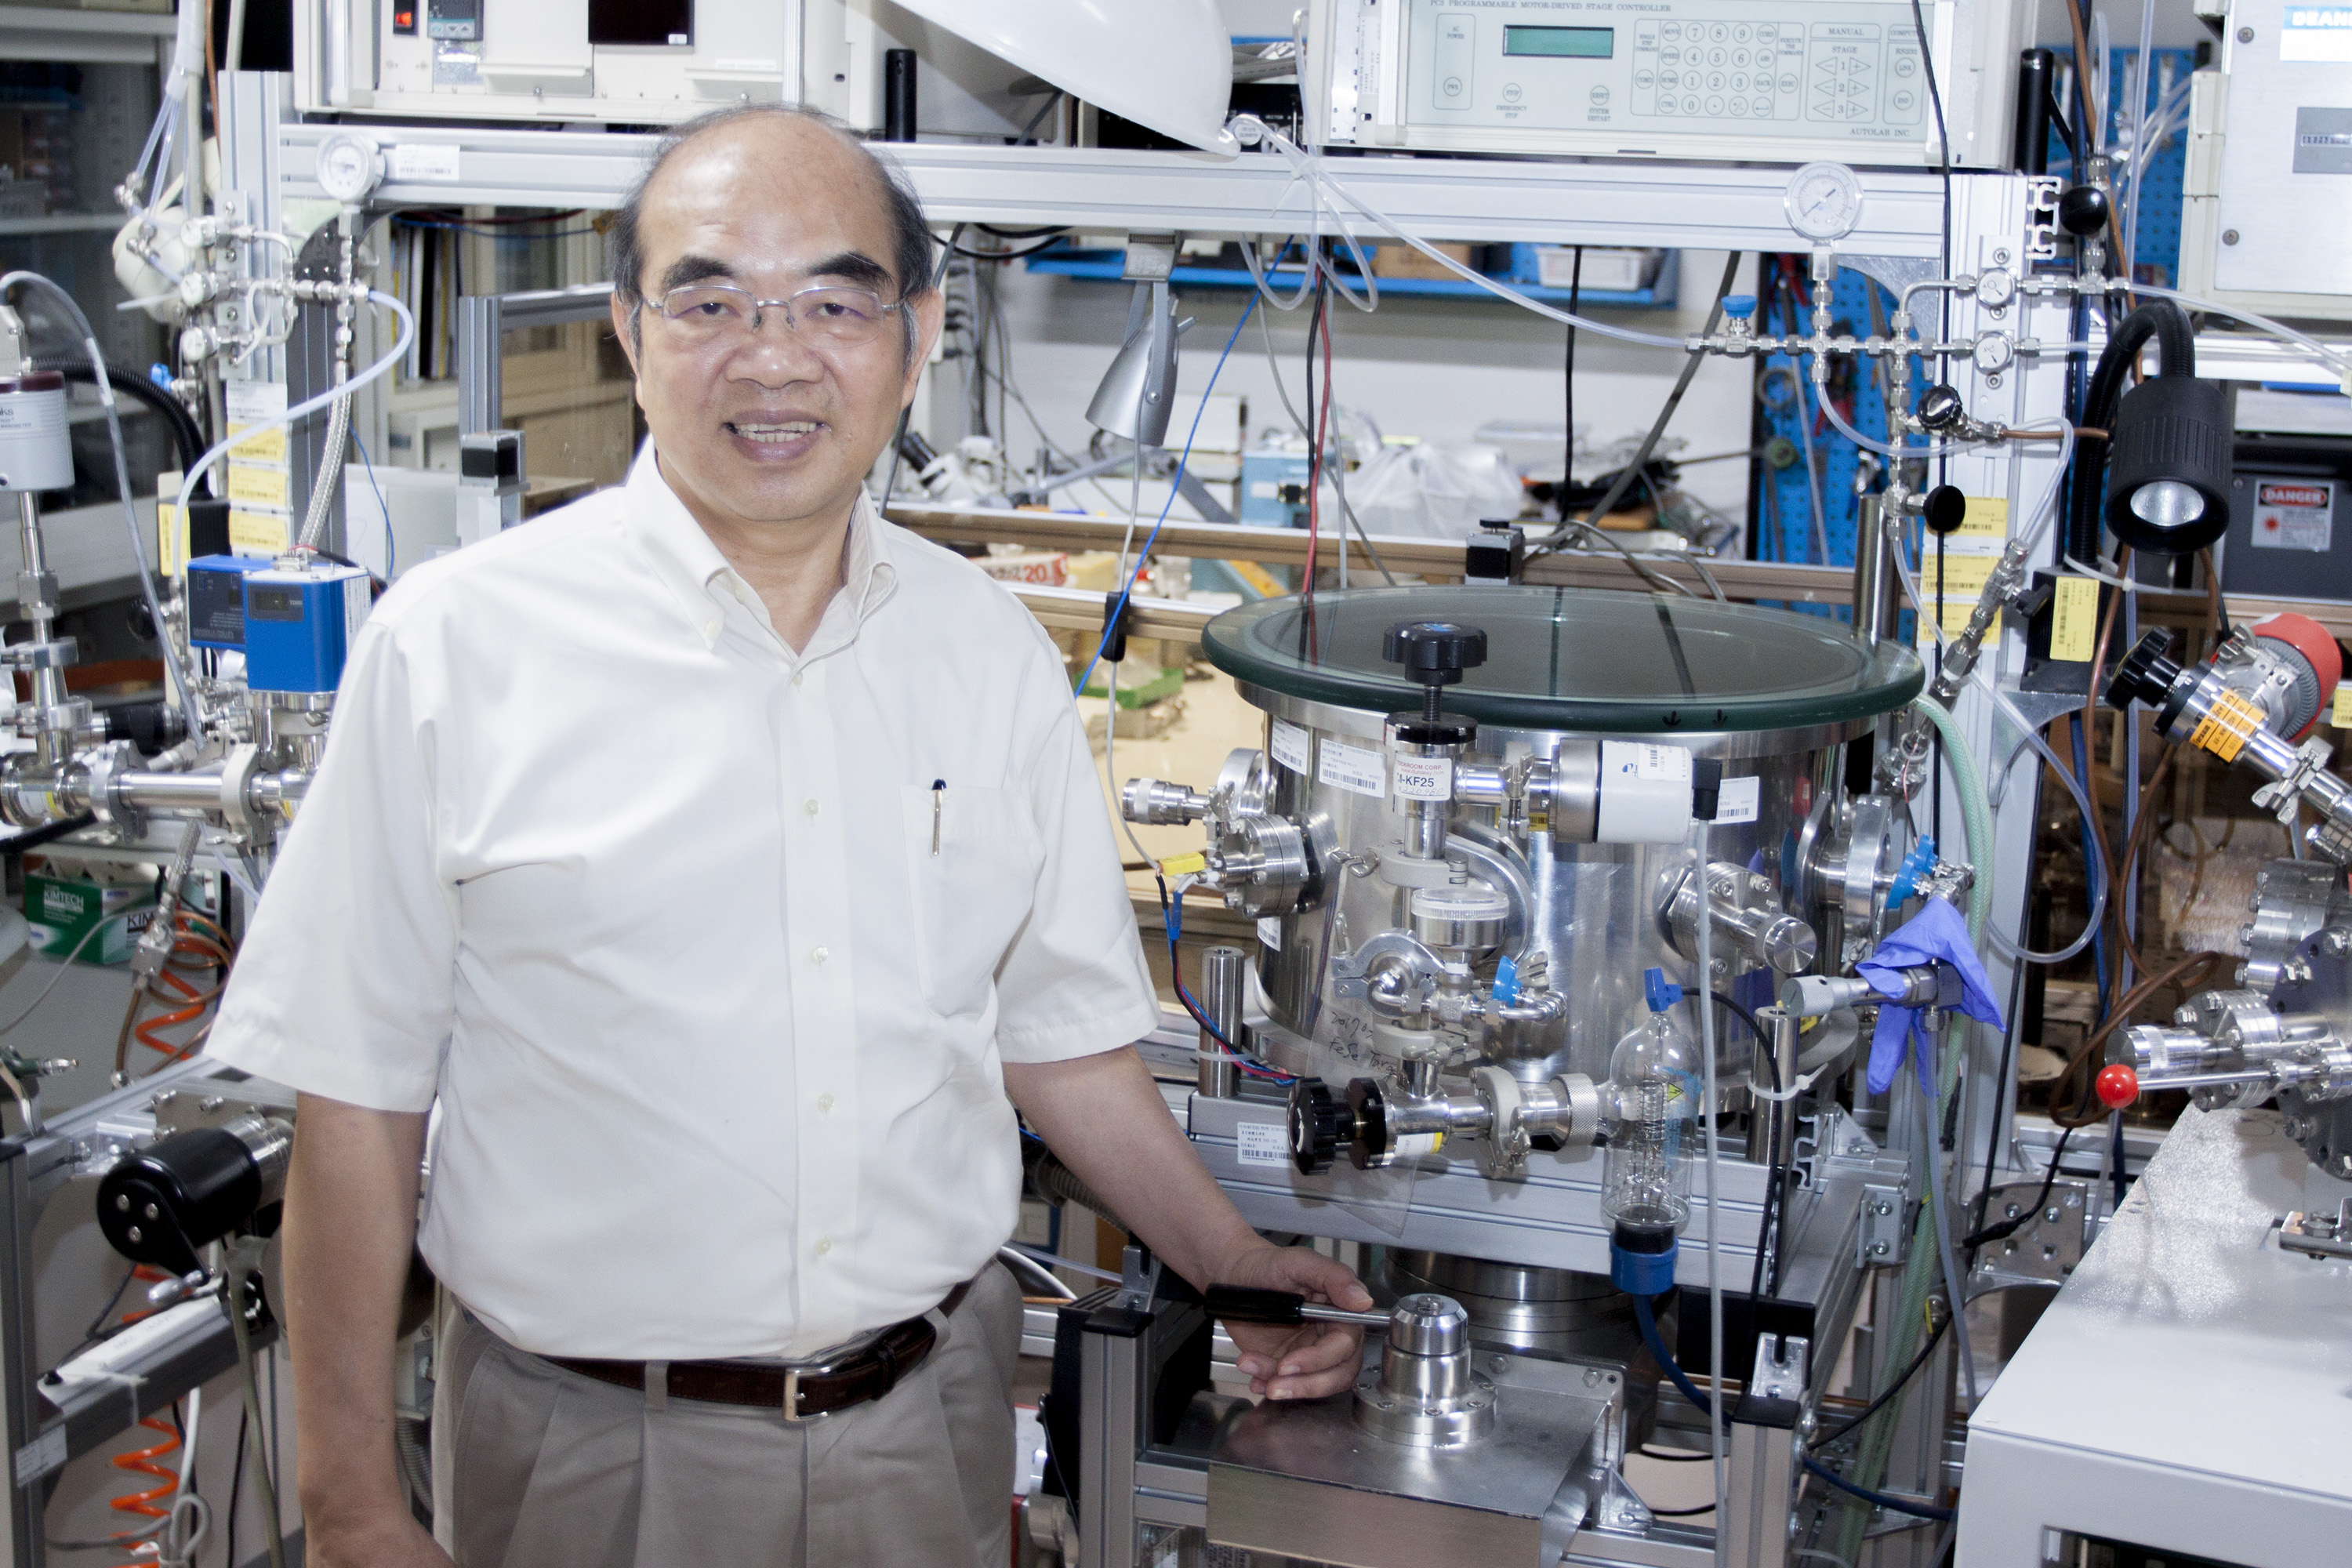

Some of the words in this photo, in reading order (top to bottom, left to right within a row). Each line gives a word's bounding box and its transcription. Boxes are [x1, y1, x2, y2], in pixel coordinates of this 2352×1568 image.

[1449, 0, 1517, 9] PROGRAMMABLE
[1520, 2, 1582, 10] MOTOR-DRIVED
[1692, 28, 1698, 37] 7
[1715, 29, 1722, 38] 8
[1739, 29, 1746, 38] 9
[1828, 27, 1864, 36] MANUAL
[1831, 45, 1857, 54] STAGE
[1690, 53, 1697, 62] 4
[1714, 53, 1721, 62] 5
[1737, 53, 1744, 63] 6
[1841, 62, 1846, 71] 1
[1690, 77, 1695, 86] 1
[1712, 78, 1719, 87] 2
[1736, 78, 1743, 88] 3
[1838, 84, 1845, 93] 2
[1688, 101, 1694, 111] 0
[1838, 105, 1844, 114] 3
[1849, 128, 1890, 137] AUTOLAB
[2265, 488, 2321, 503] DANGER
